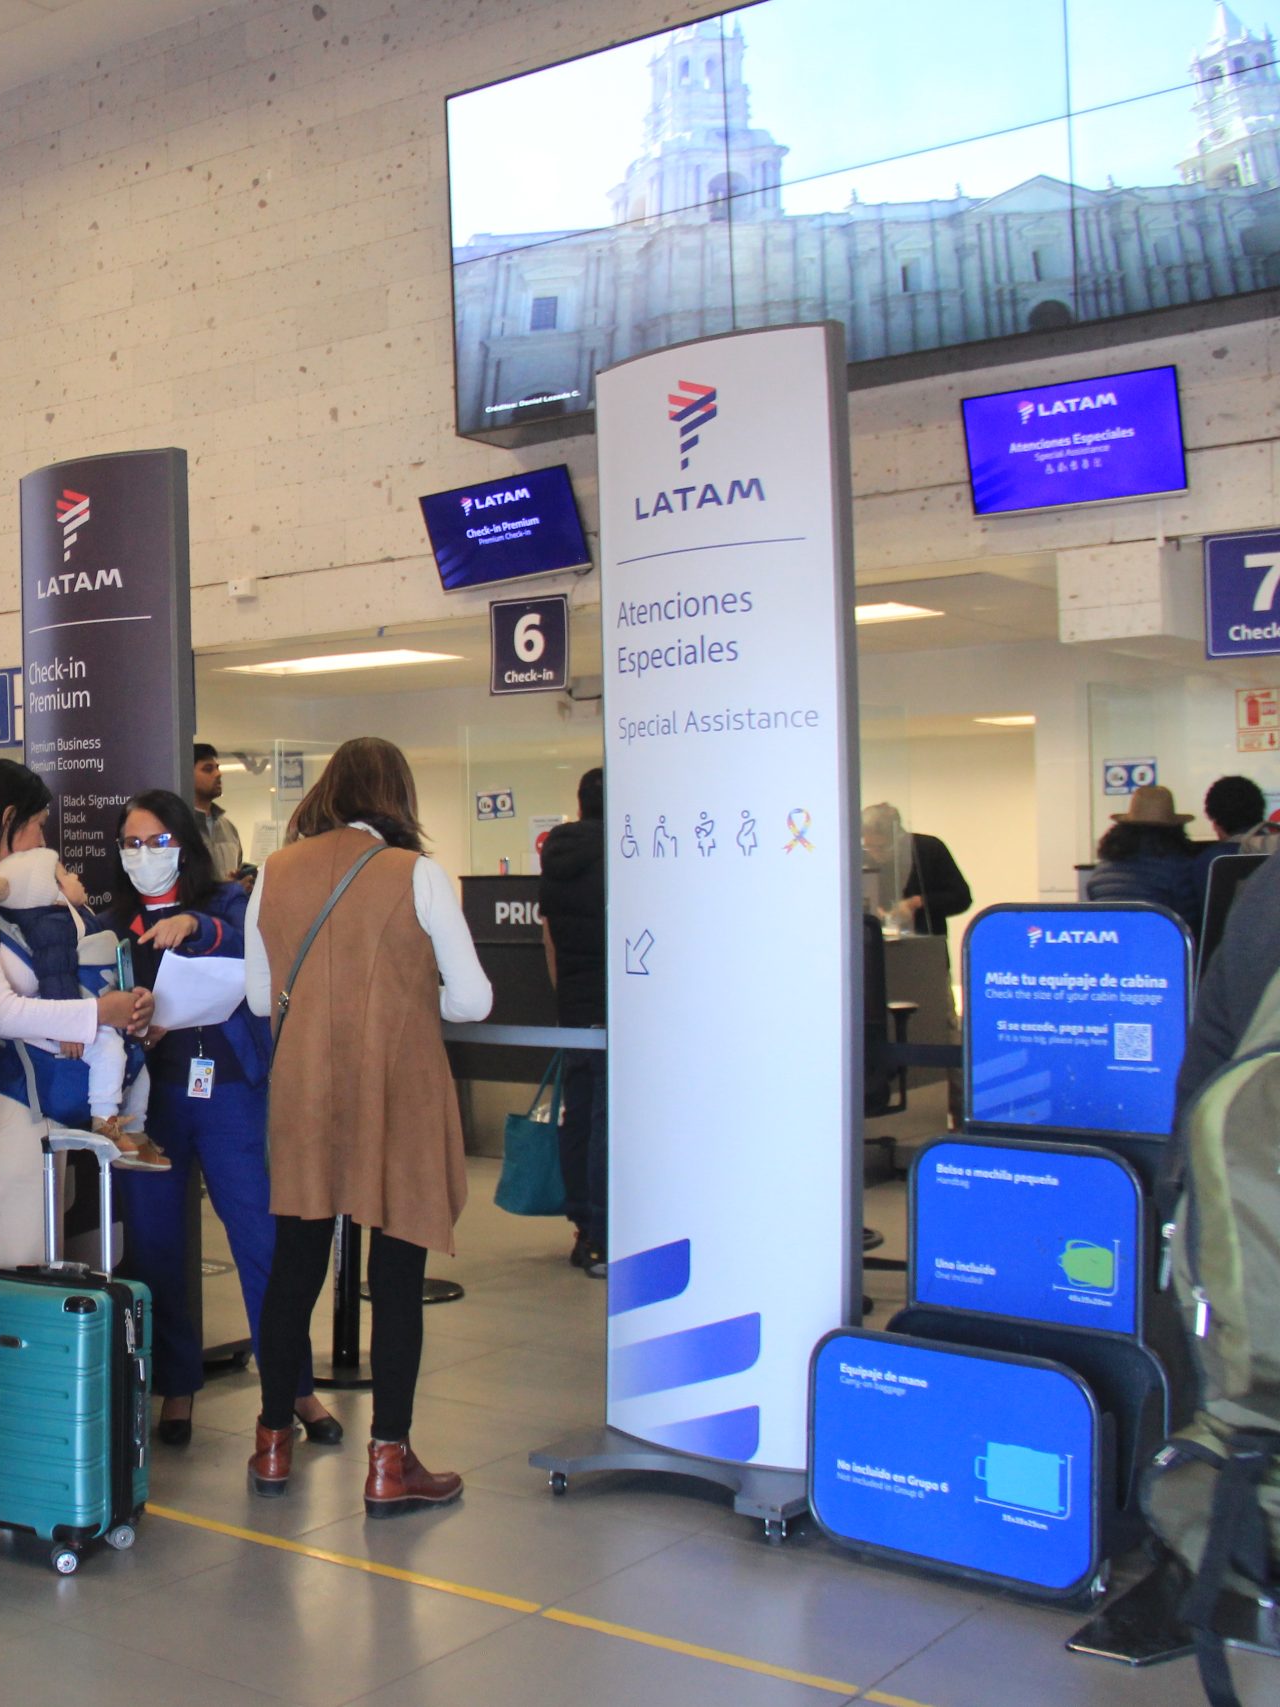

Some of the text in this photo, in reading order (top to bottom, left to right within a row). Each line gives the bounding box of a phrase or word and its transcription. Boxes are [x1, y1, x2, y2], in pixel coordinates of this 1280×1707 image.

[519, 397, 542, 407] Daniel
[1037, 392, 1118, 417] LATAM
[1009, 427, 1136, 454] Atenciones Especiales
[475, 488, 531, 510] LATAM
[634, 477, 765, 521] LATAM
[466, 517, 540, 539] Check-in Premium
[504, 529, 532, 540] Check-in
[37, 568, 123, 599] LATAM
[1244, 552, 1280, 612] 7
[617, 592, 753, 629] Atenciones
[514, 613, 545, 663] 6
[618, 634, 739, 679] Especiales
[29, 656, 86, 685] Check-in
[504, 668, 554, 684] Check-in
[30, 688, 91, 714] Premium
[619, 707, 819, 745] Special Assistance
[31, 737, 101, 754] Premium Business
[31, 757, 104, 773] Premium Economy
[63, 794, 131, 809] Black Signatur
[64, 812, 86, 824] Black
[64, 829, 104, 840] Platinum
[64, 845, 106, 858] Gold Plus
[64, 862, 84, 874] Gold
[1045, 930, 1119, 944] LATAM
[985, 972, 1168, 990] Mide tu equipaje de cabina
[985, 988, 1163, 1005] Check the size of your cabin baggage
[996, 1020, 1007, 1031] Si
[1008, 1022, 1019, 1031] se
[1059, 1024, 1084, 1035] paga
[936, 1163, 964, 1176] Bolsa
[965, 1168, 972, 1177] o
[973, 1169, 1013, 1181] mochila
[935, 1258, 997, 1276] Uno incluido
[840, 1362, 928, 1388] Equipaje de mano
[837, 1458, 949, 1493] No incluido en Grupo 6
